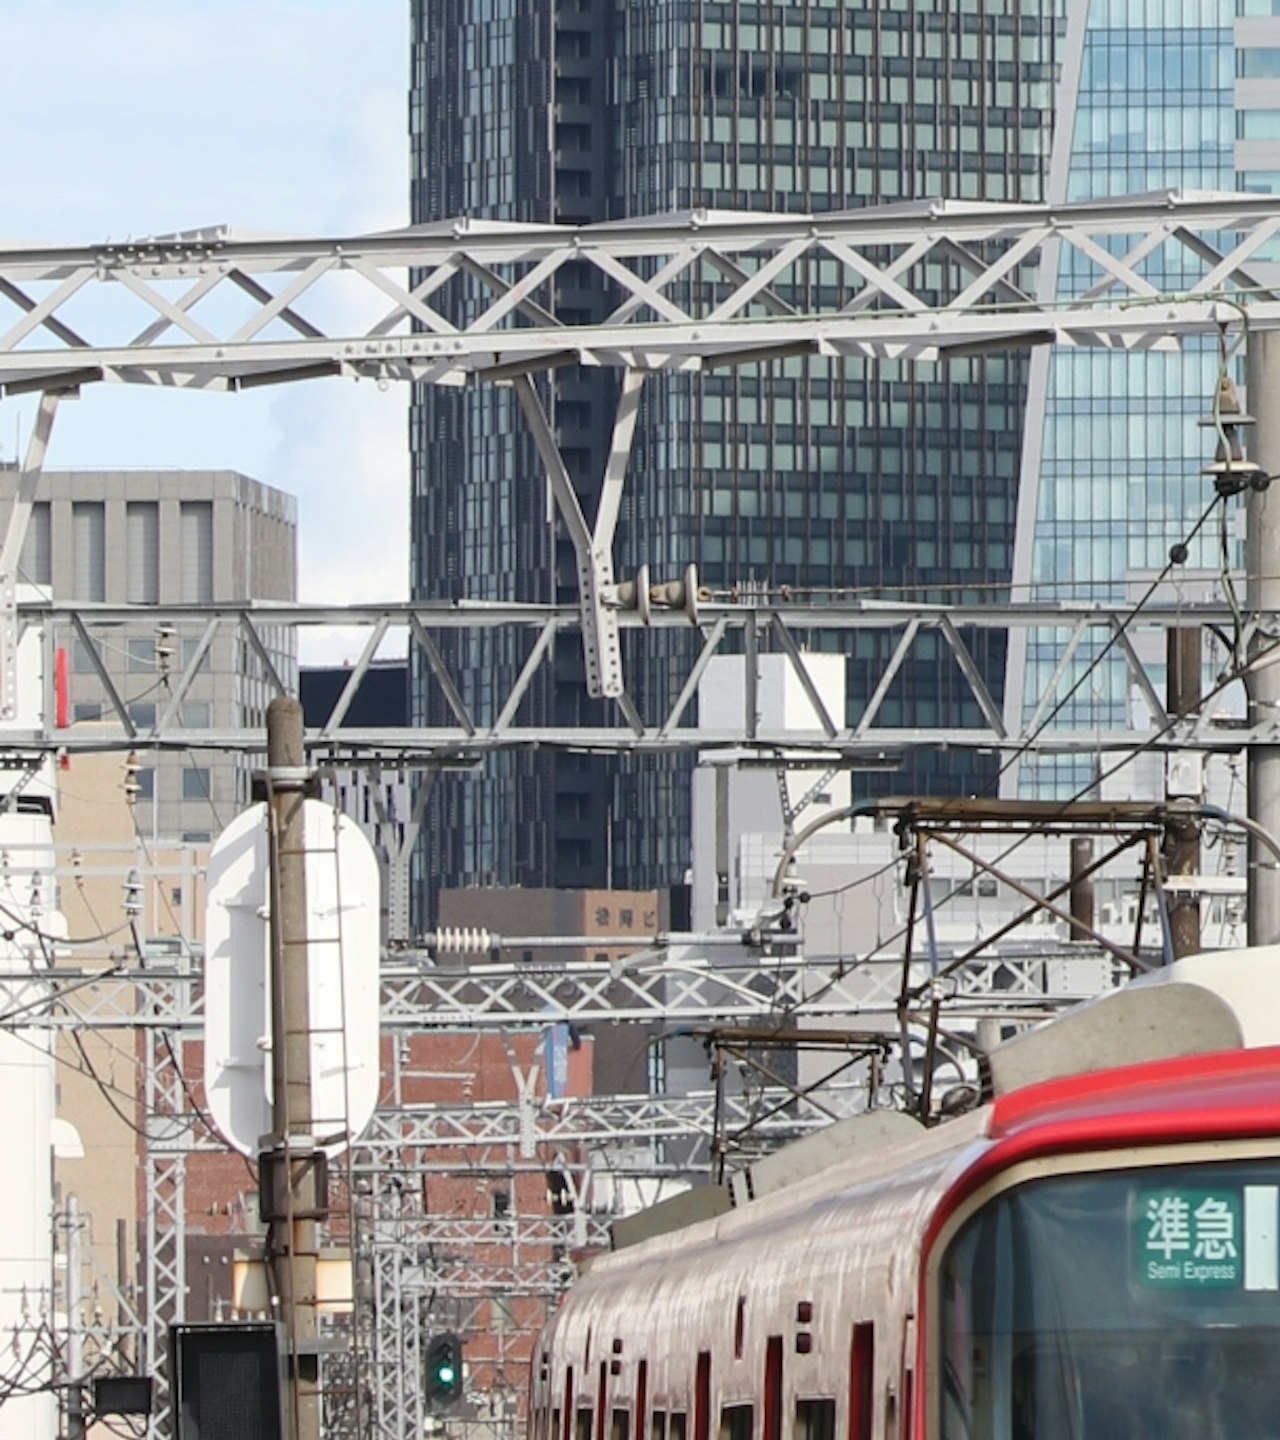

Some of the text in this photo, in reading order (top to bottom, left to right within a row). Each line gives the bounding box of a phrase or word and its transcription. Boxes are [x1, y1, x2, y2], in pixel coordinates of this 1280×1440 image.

[1146, 1197, 1237, 1260] 準急
[1147, 1263, 1236, 1283] Semi Express
